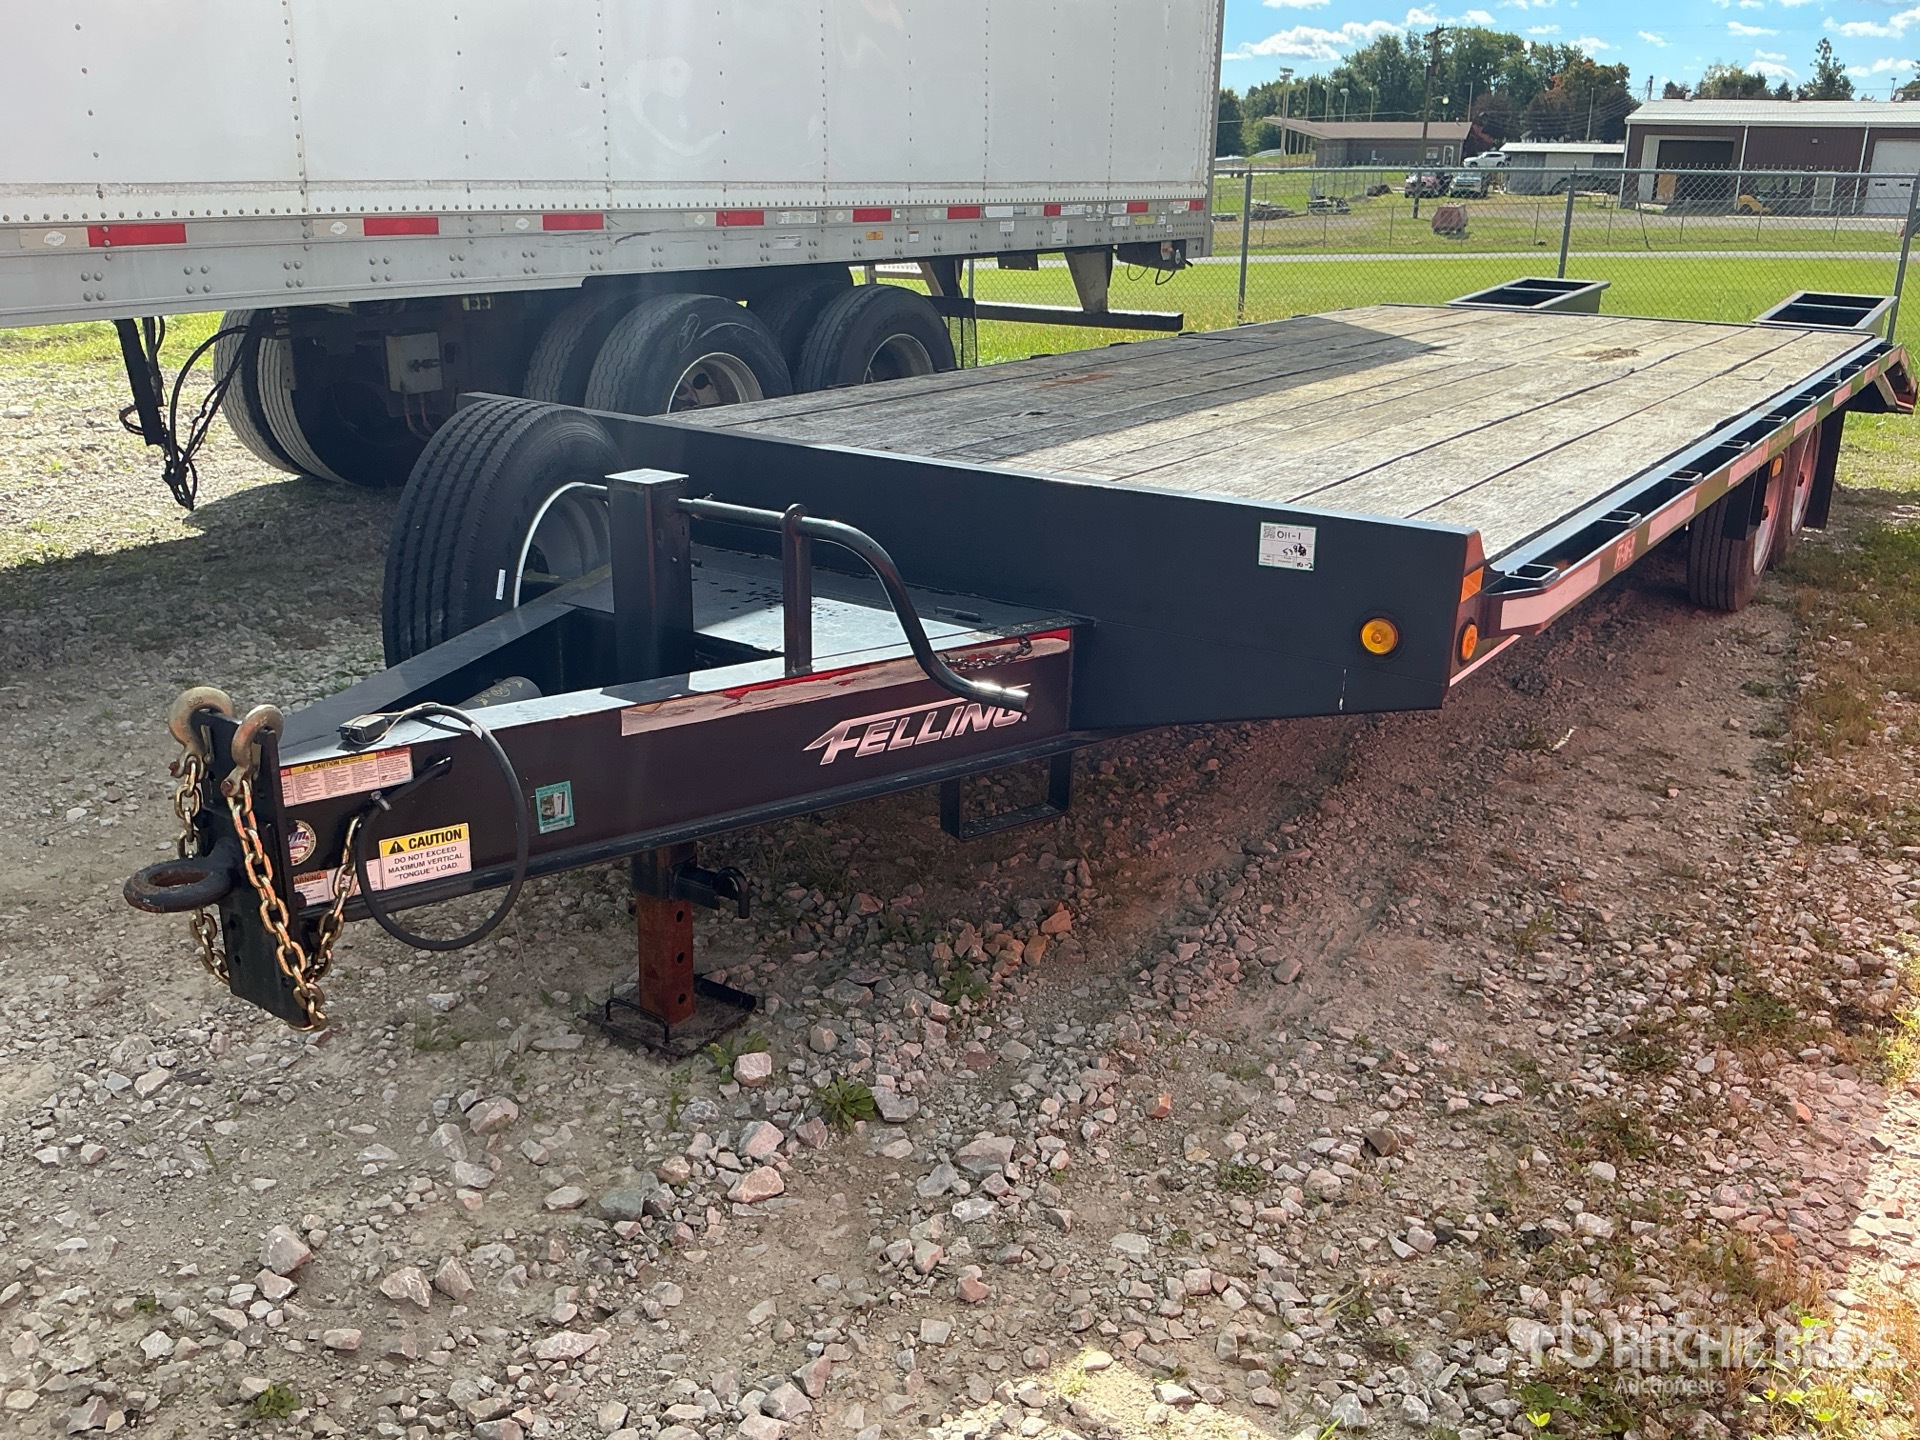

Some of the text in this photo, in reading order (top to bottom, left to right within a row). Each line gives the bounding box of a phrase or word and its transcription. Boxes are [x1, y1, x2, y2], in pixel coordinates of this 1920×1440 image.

[803, 697, 1023, 765] FELLING
[312, 760, 340, 770] CAUTION
[408, 828, 462, 849] CAUTION
[388, 853, 464, 874] MAXIMUM VERTICAL
[394, 846, 457, 865] DO NOT EXCEED
[436, 863, 459, 872] LOAD.
[294, 873, 322, 885] ARNING
